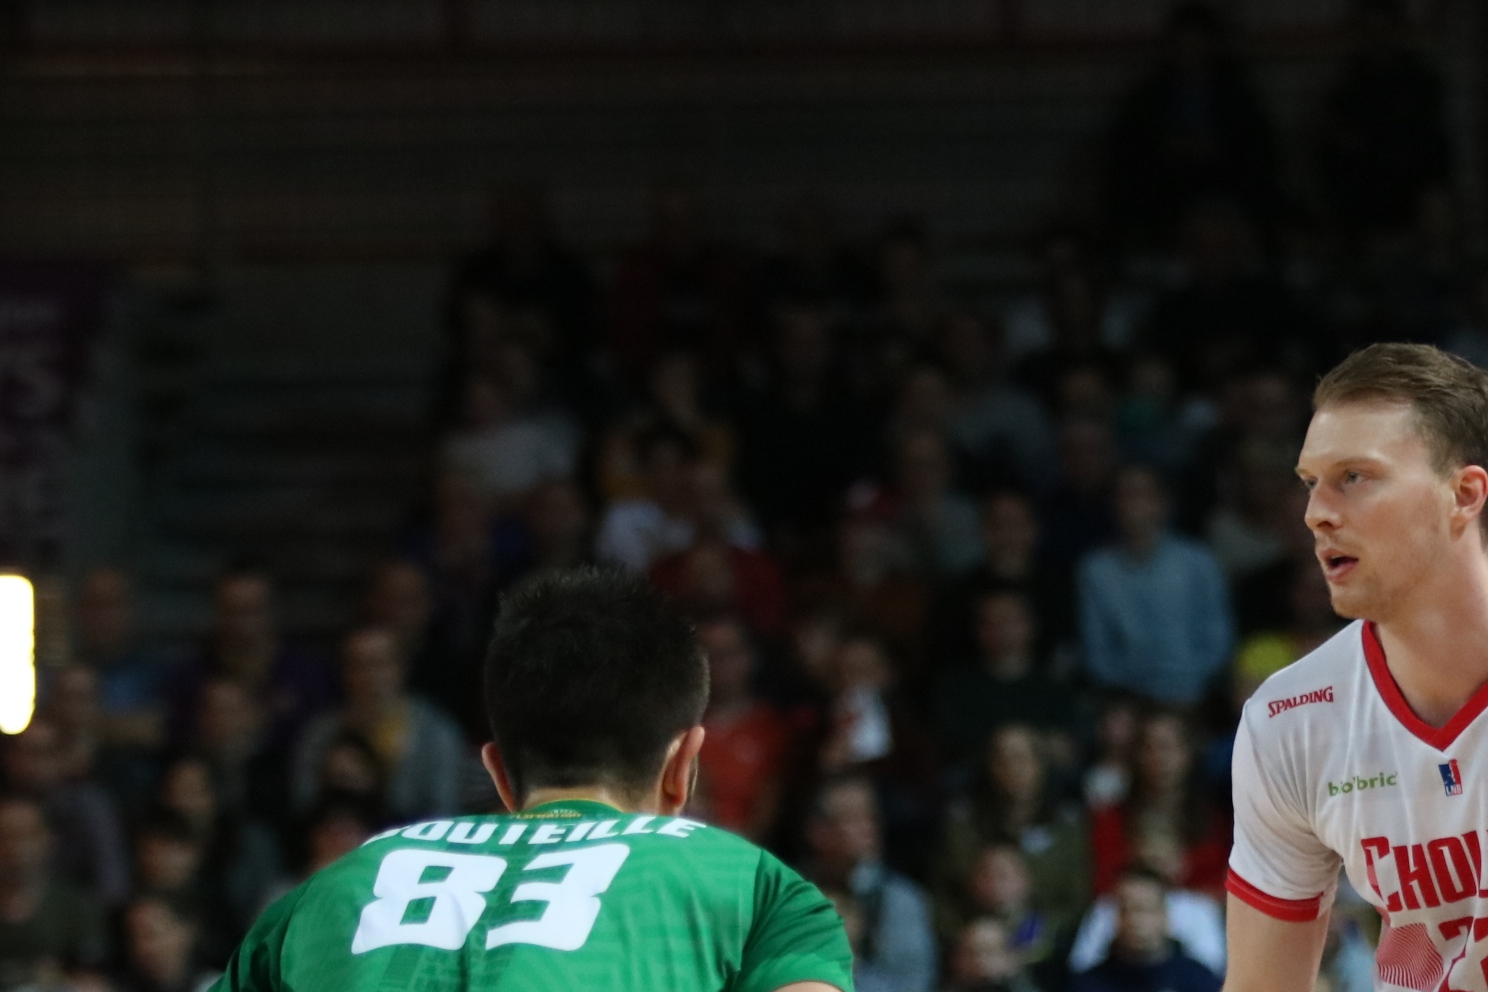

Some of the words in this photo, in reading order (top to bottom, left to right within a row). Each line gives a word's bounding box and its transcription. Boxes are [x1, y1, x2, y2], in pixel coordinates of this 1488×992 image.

[1267, 686, 1335, 719] SPALDING
[1445, 784, 1463, 796] LNB
[350, 843, 631, 956] 83
